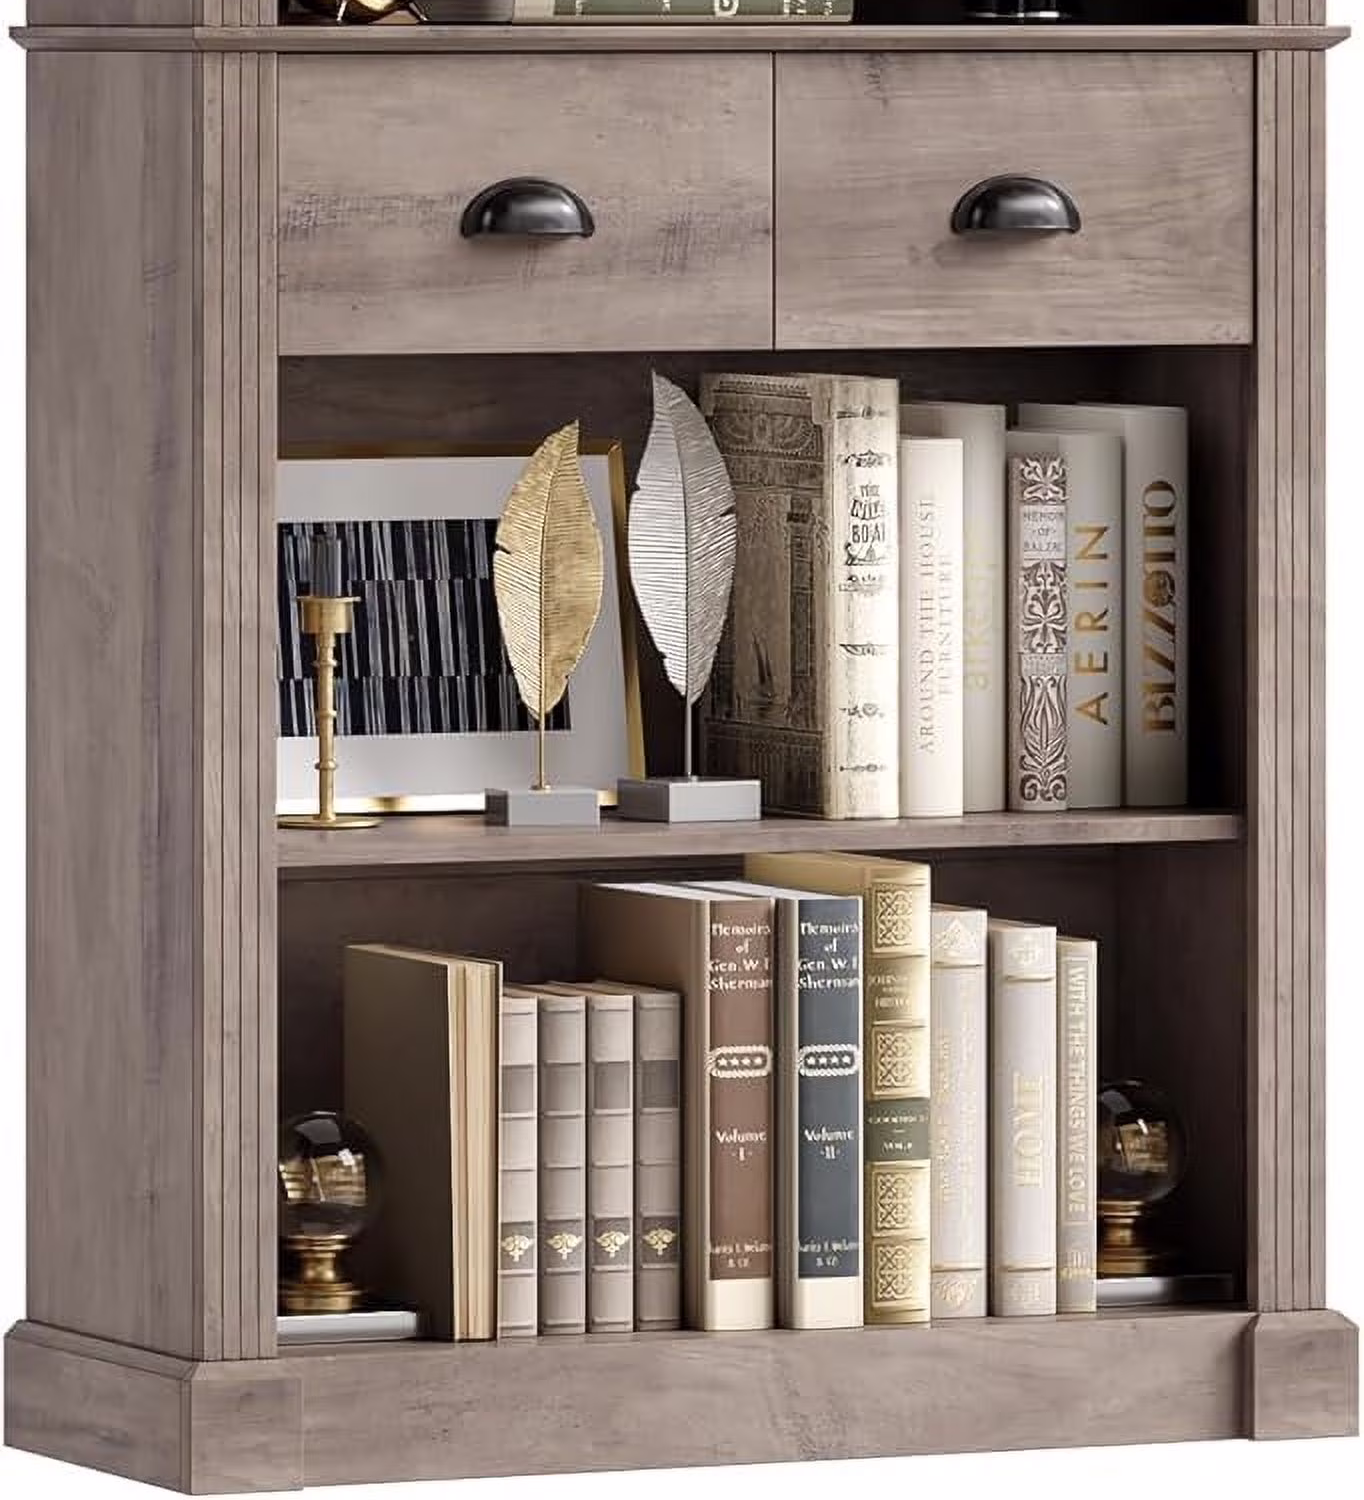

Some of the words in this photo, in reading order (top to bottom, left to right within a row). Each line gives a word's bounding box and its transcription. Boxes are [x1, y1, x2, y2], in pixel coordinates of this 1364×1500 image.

[1074, 525, 1110, 726] AERIN
[919, 650, 934, 755] AROUND
[1067, 966, 1087, 1015] WITH
[1067, 1023, 1087, 1057] THE
[1067, 1058, 1087, 1129] THINGS
[716, 1128, 767, 1143] Volume
[804, 1127, 854, 1142] Volume
[1013, 1072, 1043, 1188] HOME
[1067, 1132, 1087, 1165] WE
[1067, 1169, 1087, 1213] LOVE
